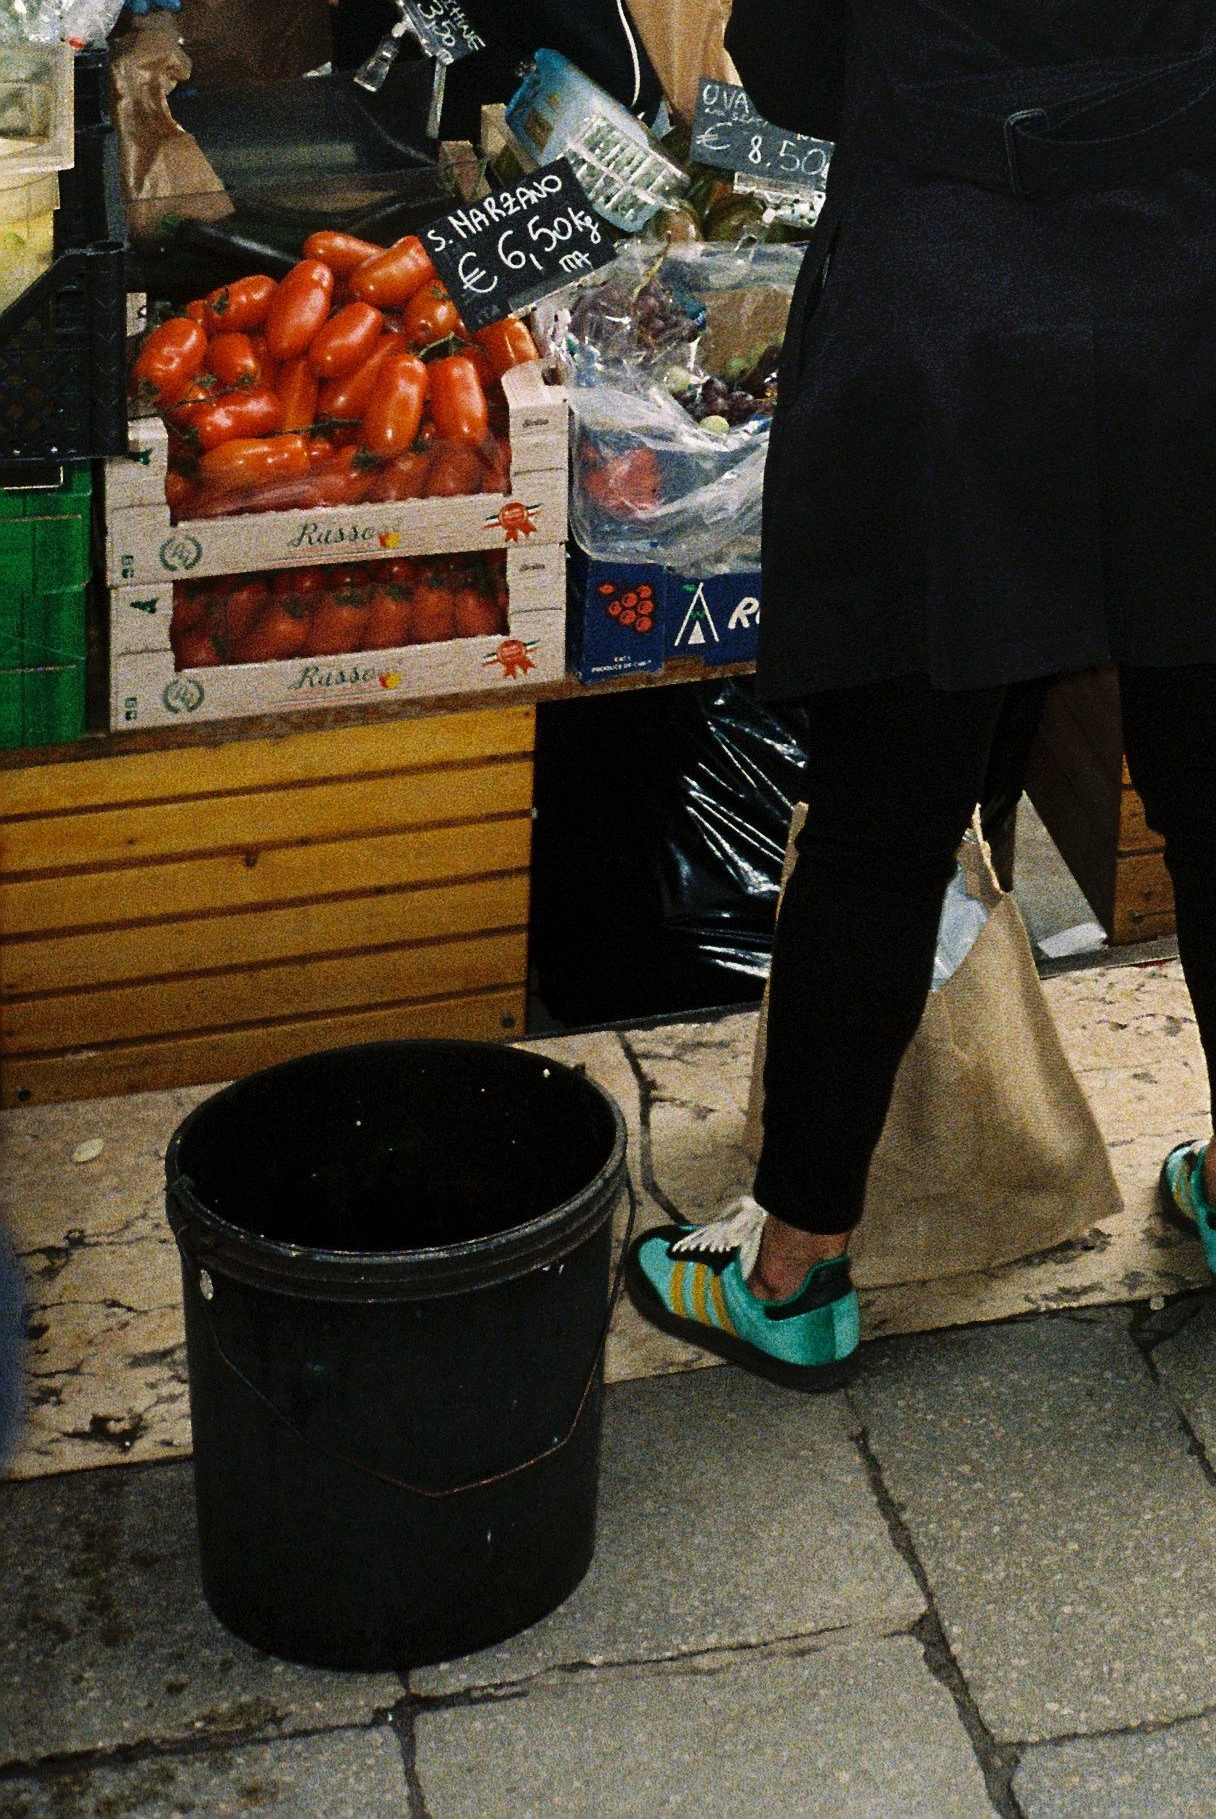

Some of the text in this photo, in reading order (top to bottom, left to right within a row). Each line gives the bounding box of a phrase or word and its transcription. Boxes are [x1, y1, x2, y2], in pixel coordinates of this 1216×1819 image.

[447, 174, 563, 239] MARZANO
[457, 251, 498, 293] €
[286, 522, 375, 548] Russo
